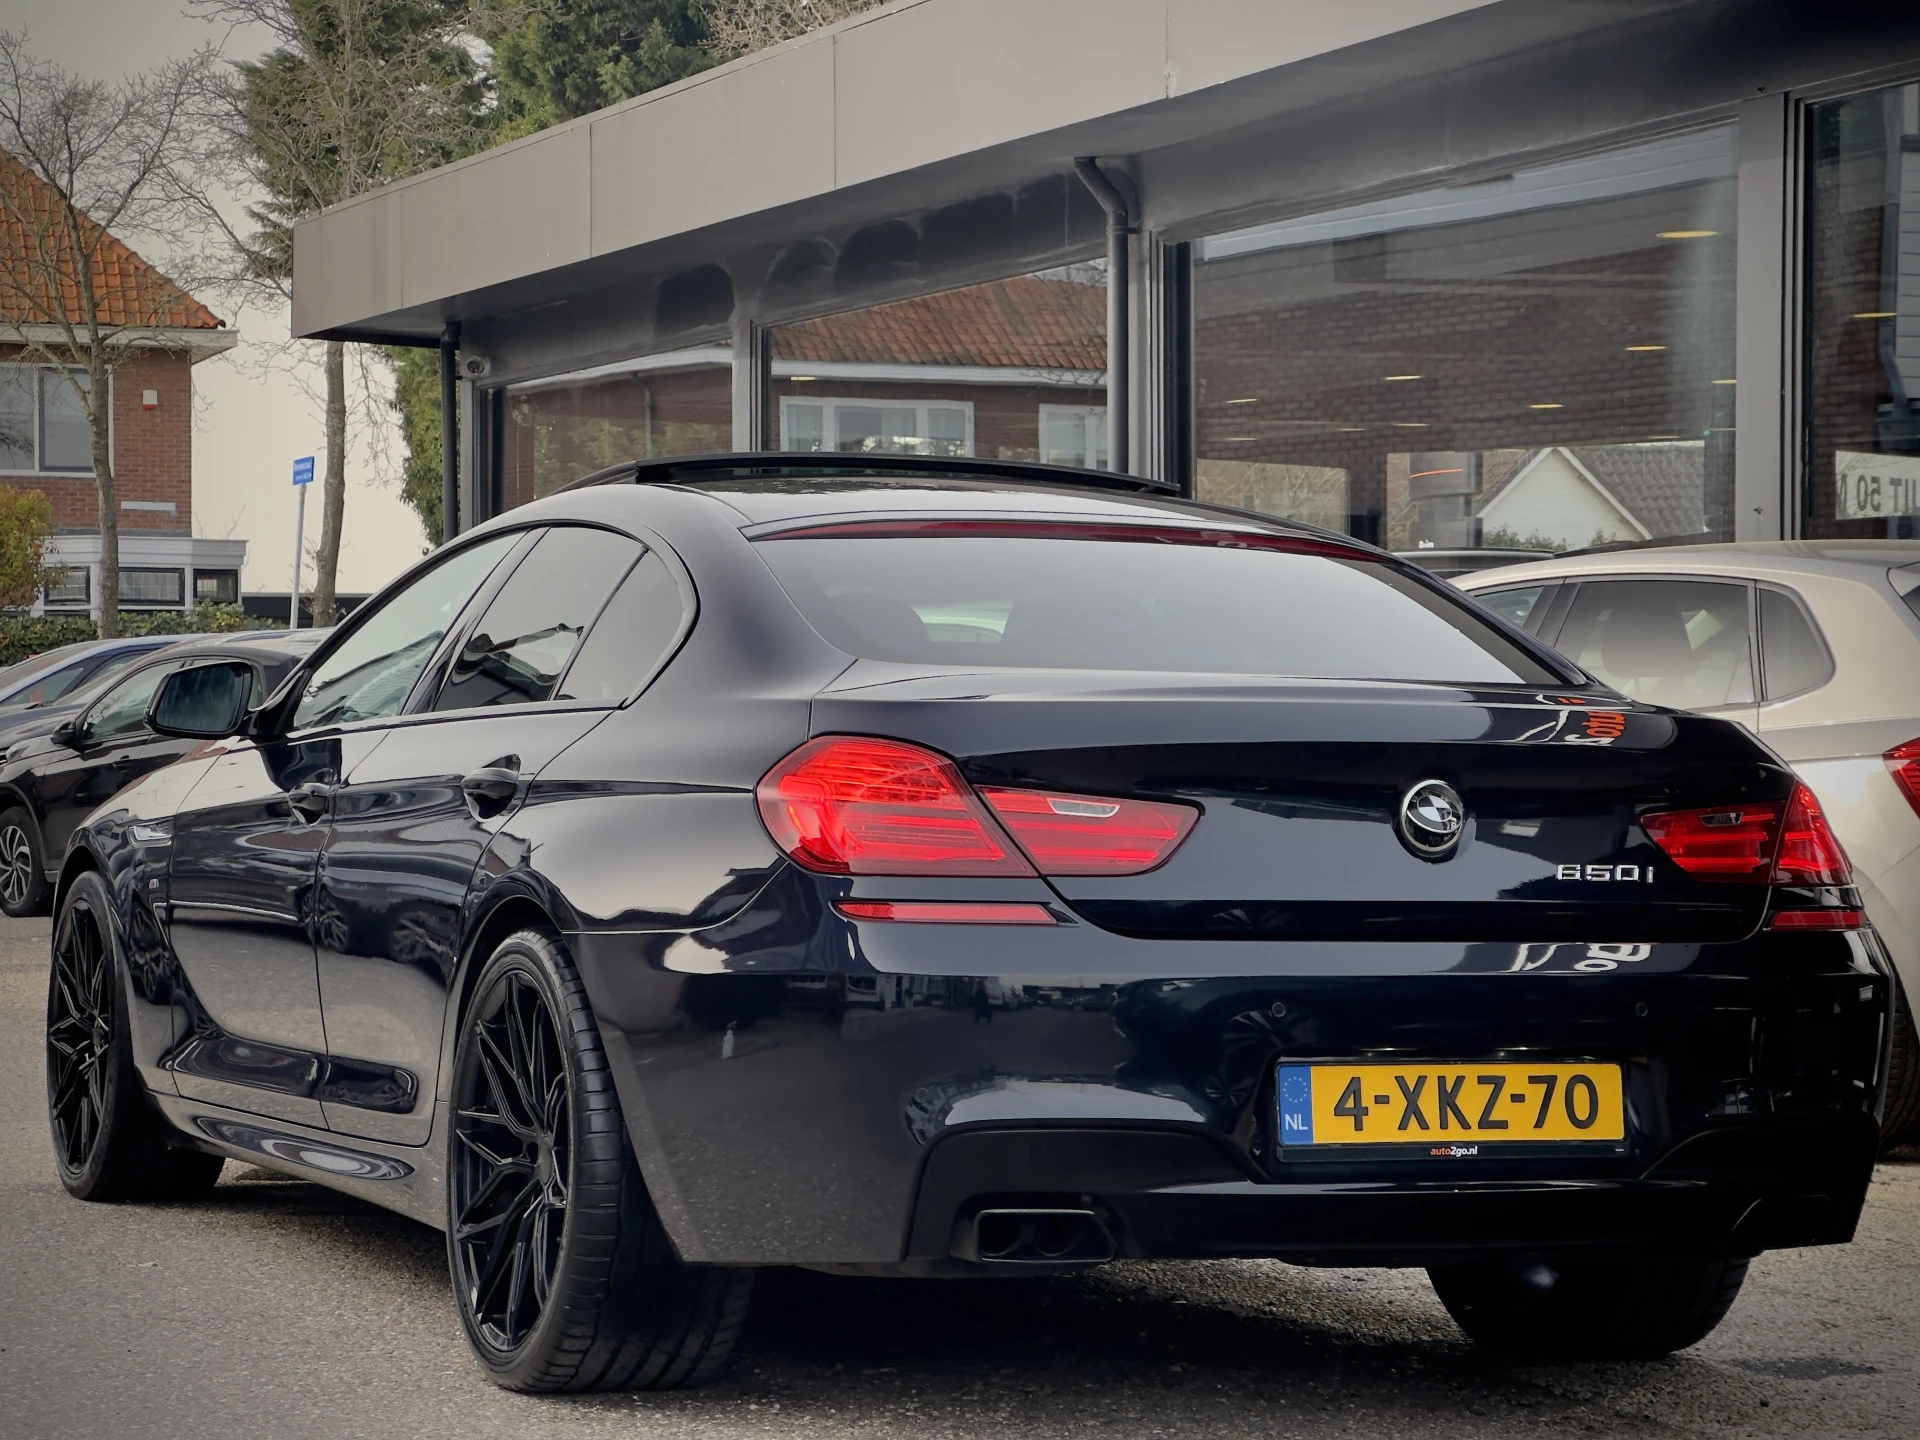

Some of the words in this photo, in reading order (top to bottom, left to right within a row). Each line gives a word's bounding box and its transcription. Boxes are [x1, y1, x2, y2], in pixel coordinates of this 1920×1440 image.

[1557, 864, 1654, 883] 650i
[1333, 1073, 1599, 1132] 4-XKZ-70
[1284, 1113, 1309, 1131] NL
[1429, 1145, 1478, 1157] auto2go.nl
